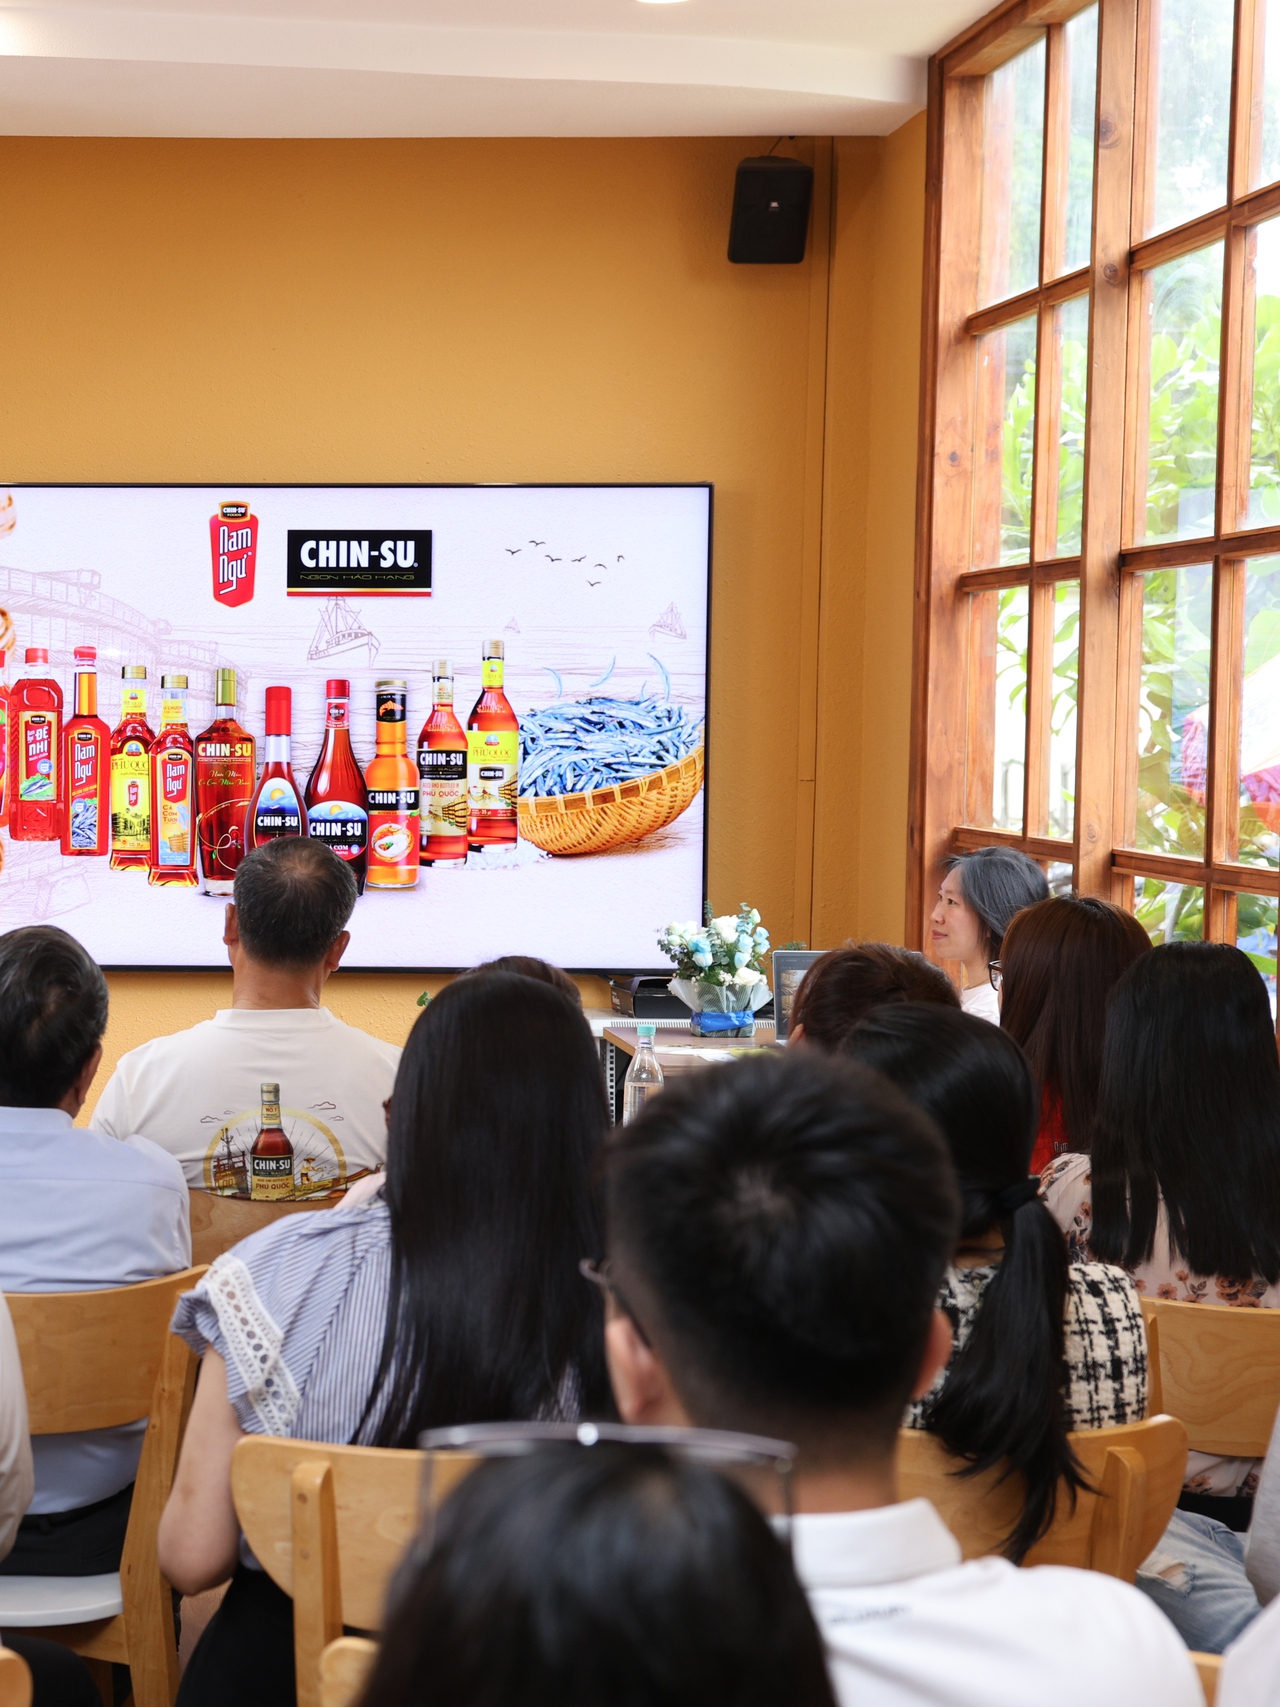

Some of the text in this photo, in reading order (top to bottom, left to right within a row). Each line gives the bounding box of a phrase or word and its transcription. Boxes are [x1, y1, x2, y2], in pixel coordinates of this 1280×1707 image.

[300, 540, 416, 568] CHIN-SU
[198, 743, 252, 757] CHIN-SU
[420, 753, 463, 766] CHIN-SU
[368, 792, 415, 804] CHIN-SU
[257, 816, 298, 827] CHIN-SU
[310, 822, 361, 836] CHIN-SU
[254, 1159, 291, 1170] CHIN-SU
